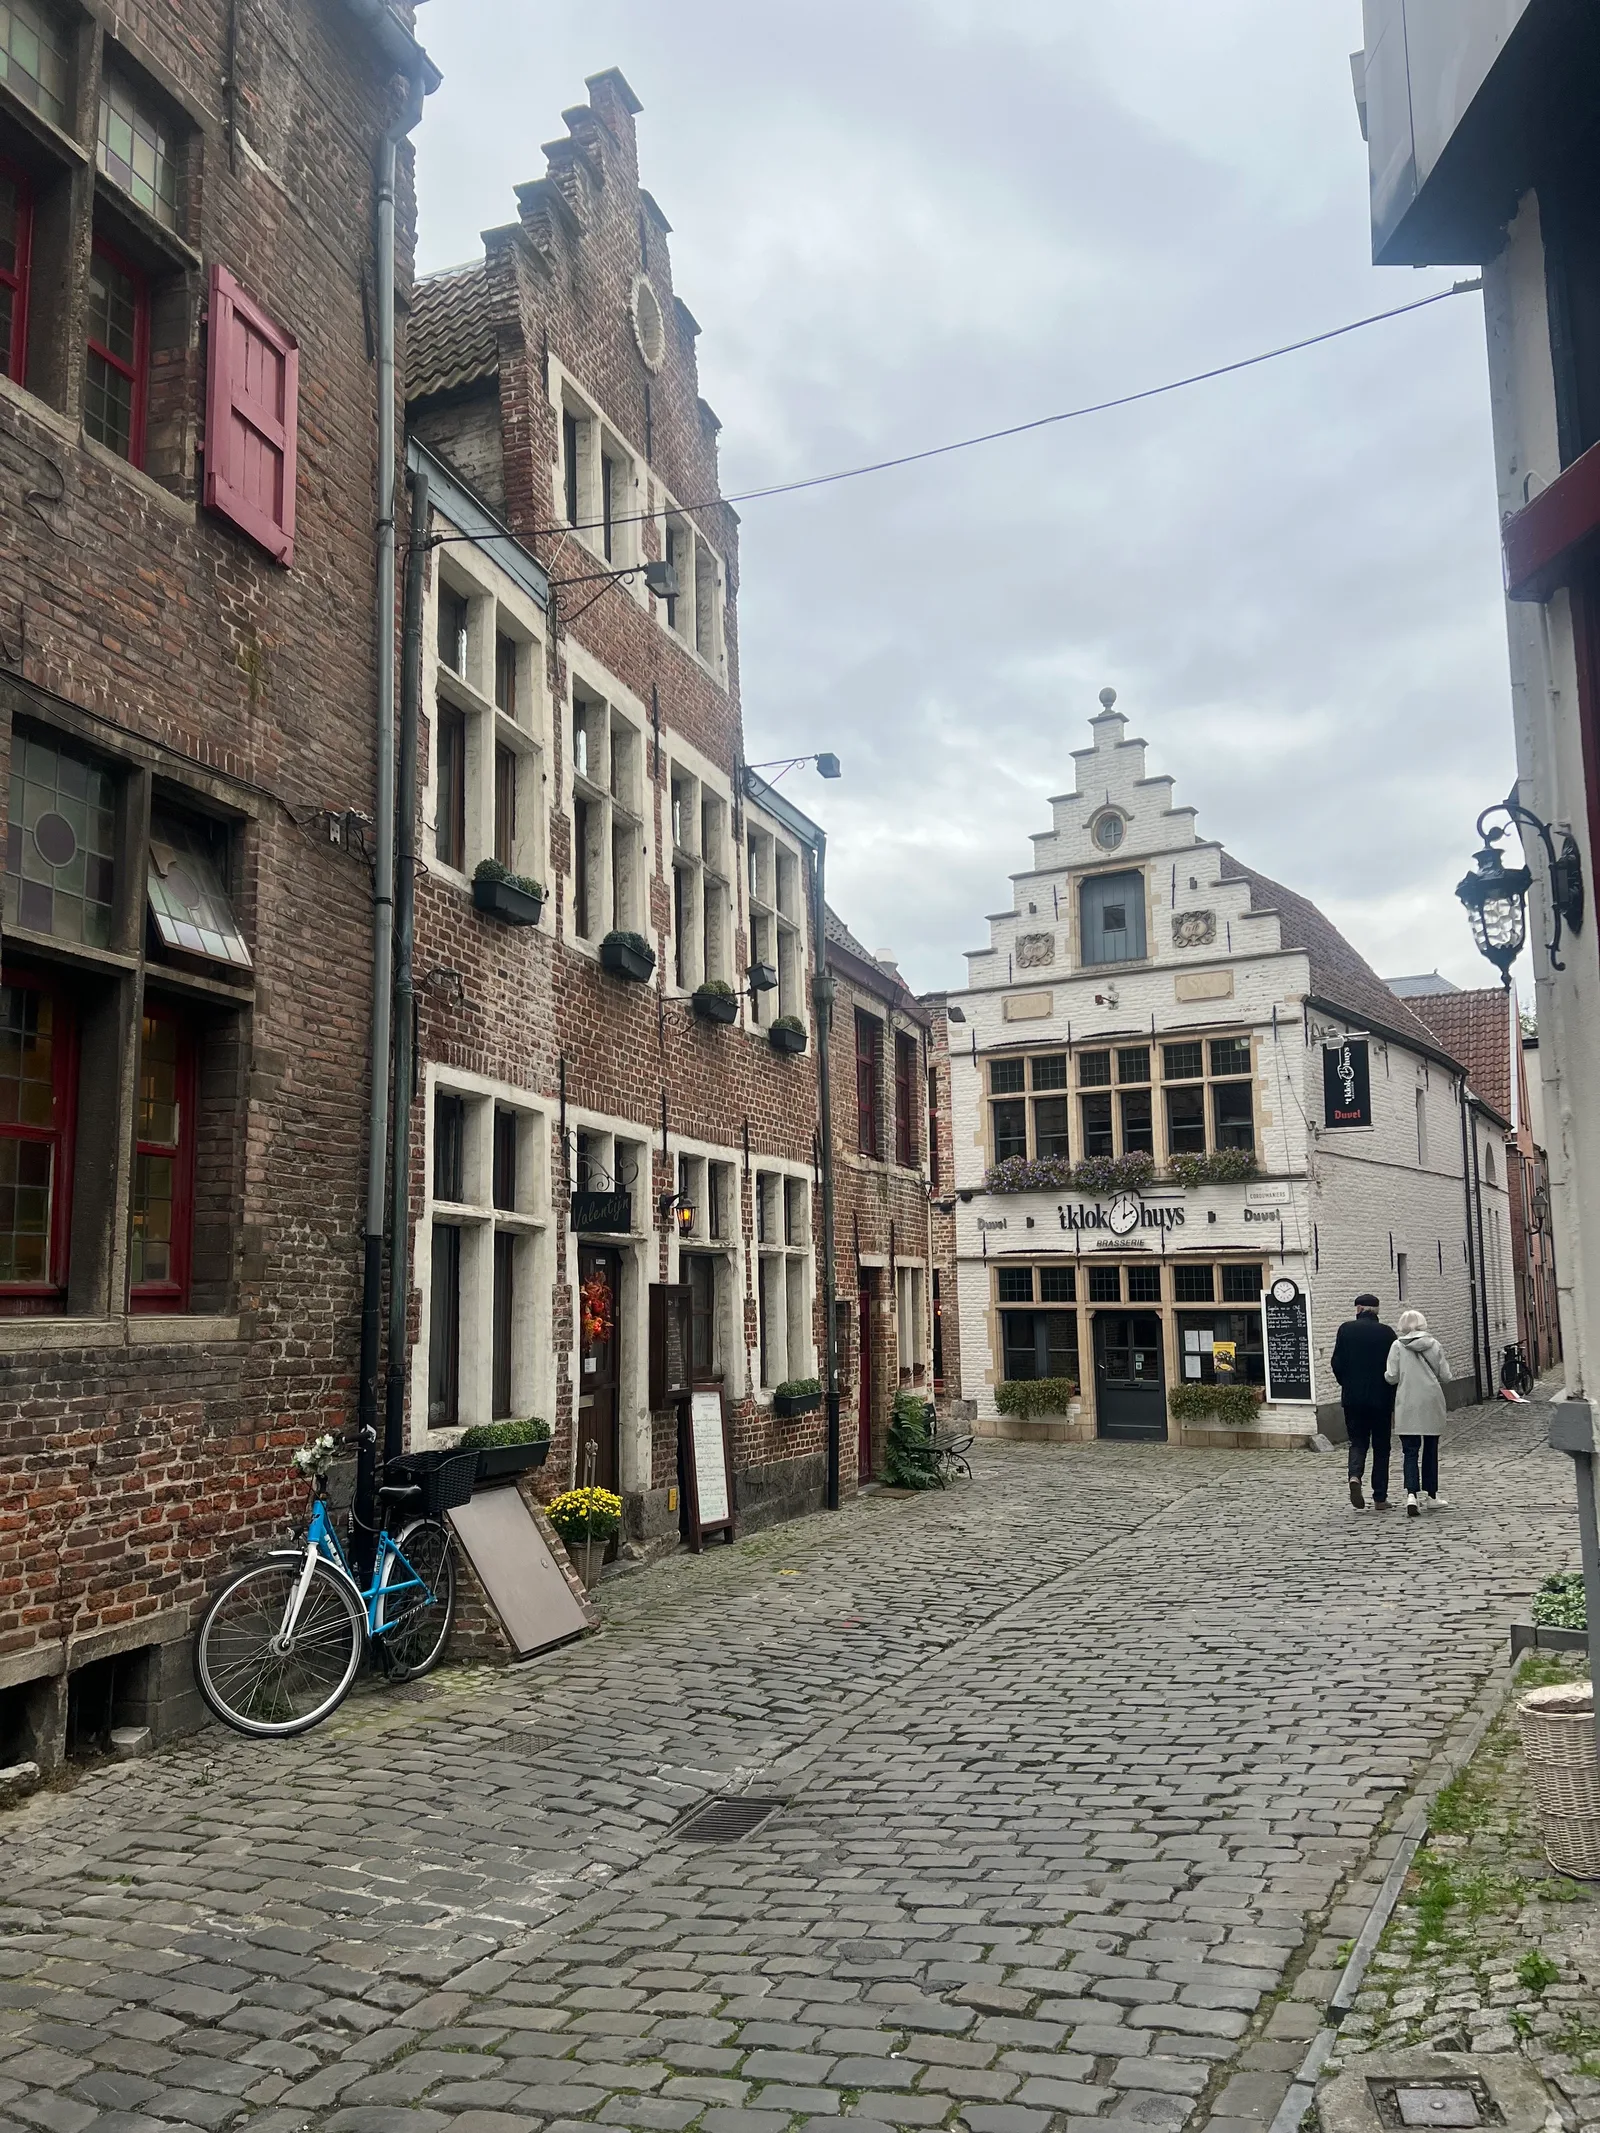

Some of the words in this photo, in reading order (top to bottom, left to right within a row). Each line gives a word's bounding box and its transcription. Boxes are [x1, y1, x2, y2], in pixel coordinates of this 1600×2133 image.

[1334, 1109, 1361, 1120] Duvel
[573, 1195, 629, 1230] Valentijn
[1139, 1202, 1185, 1231] huys
[1243, 1208, 1280, 1222] Duvel
[977, 1217, 1007, 1230] Duvel
[1096, 1239, 1145, 1248] BRASSERIE
